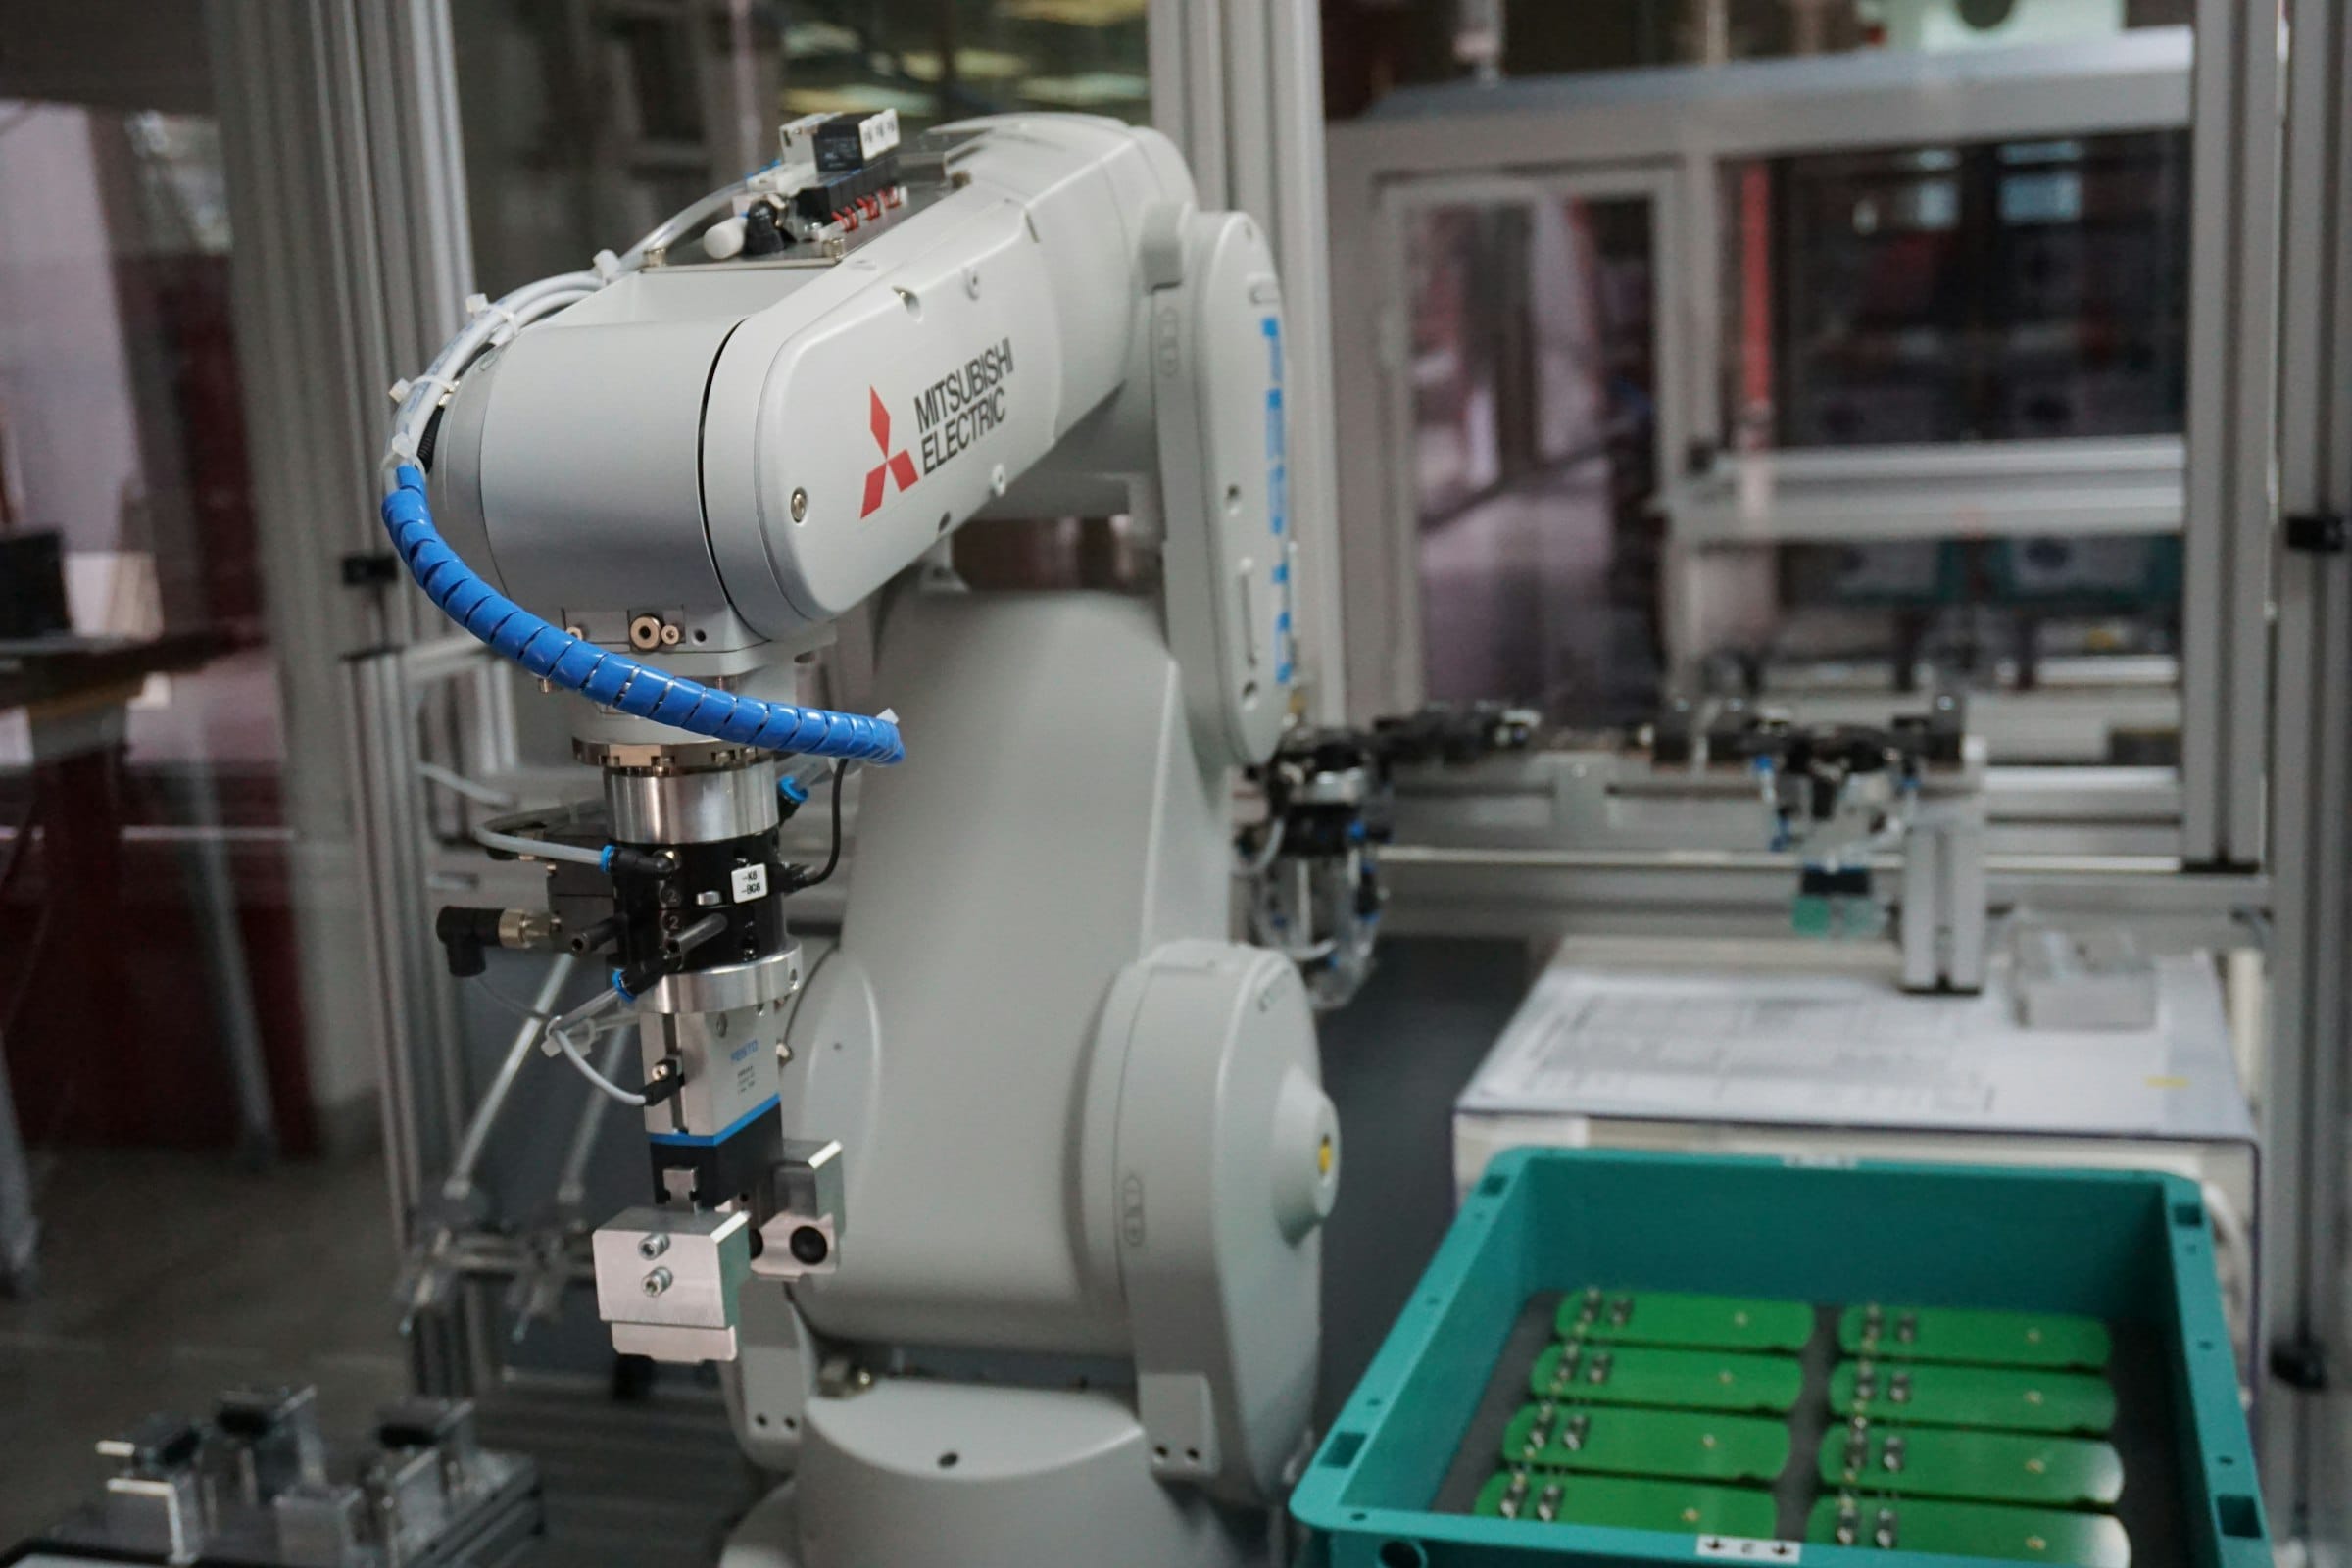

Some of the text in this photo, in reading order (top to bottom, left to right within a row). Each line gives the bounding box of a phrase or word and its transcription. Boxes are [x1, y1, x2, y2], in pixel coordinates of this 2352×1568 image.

[914, 337, 1013, 434] MITSUBISHI
[921, 386, 1005, 475] ELECTRIC
[669, 916, 679, 930] 2
